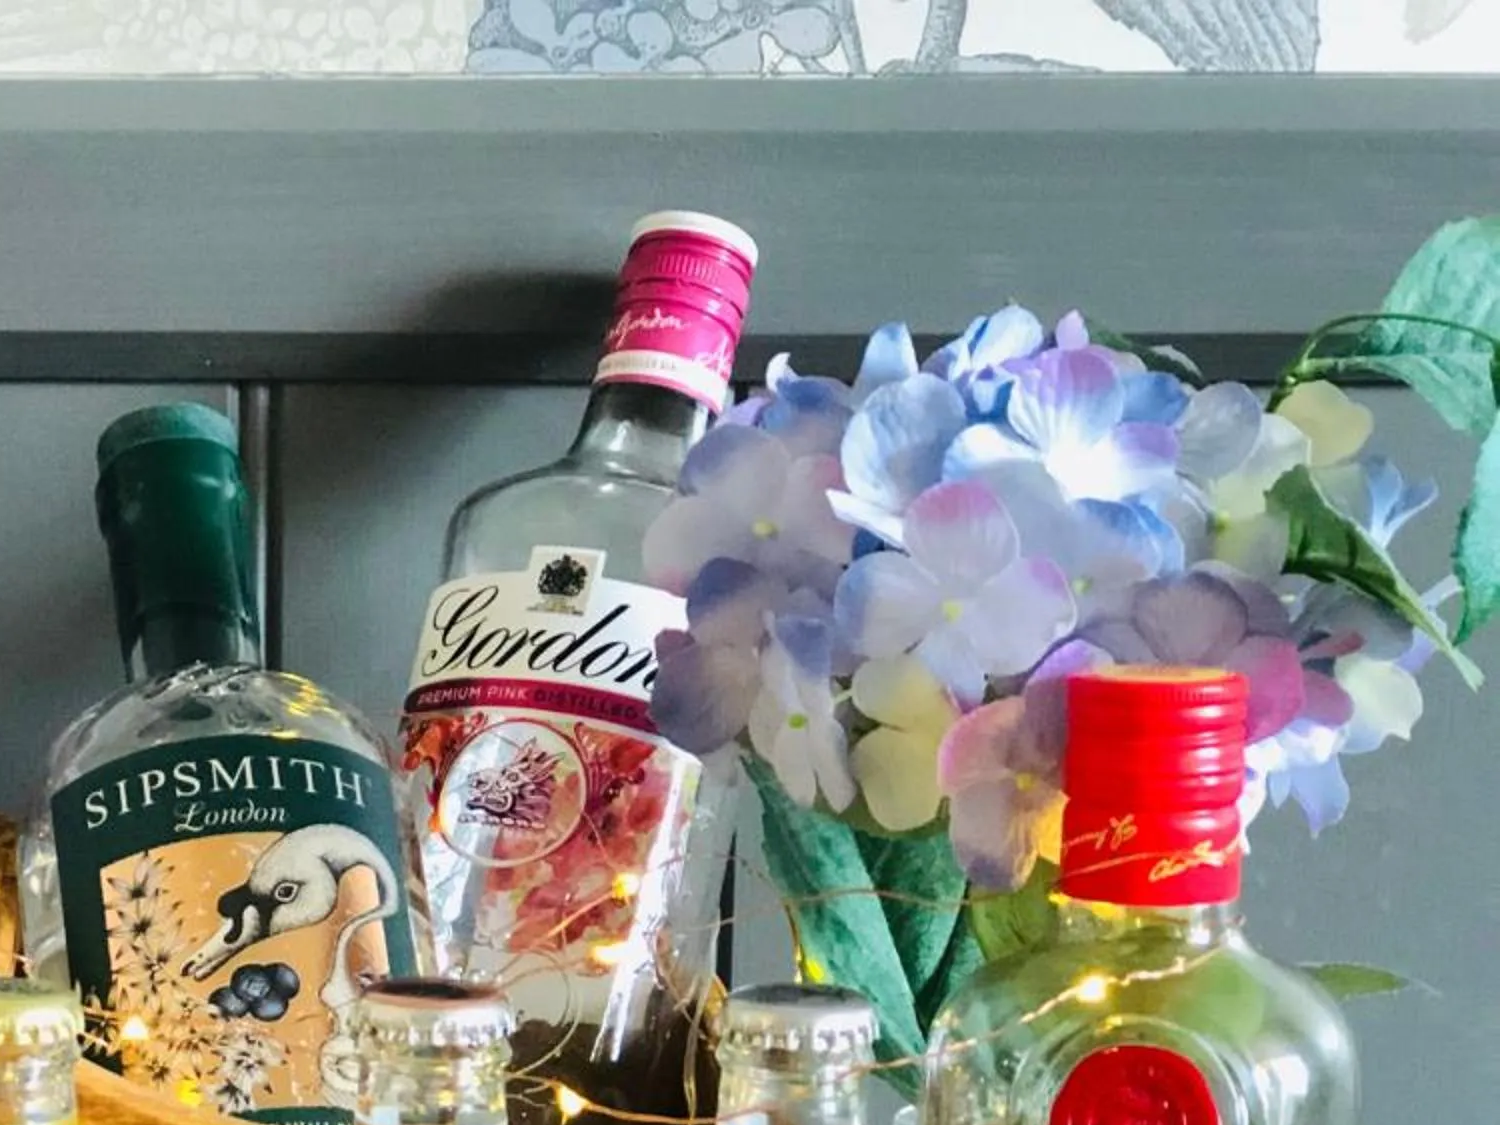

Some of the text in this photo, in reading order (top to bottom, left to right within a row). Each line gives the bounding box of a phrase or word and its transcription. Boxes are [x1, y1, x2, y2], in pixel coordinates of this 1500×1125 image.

[417, 686, 482, 705] PREMIUM
[487, 686, 528, 701] PINK
[84, 755, 366, 830] SIPSMITH
[174, 799, 287, 833] London
